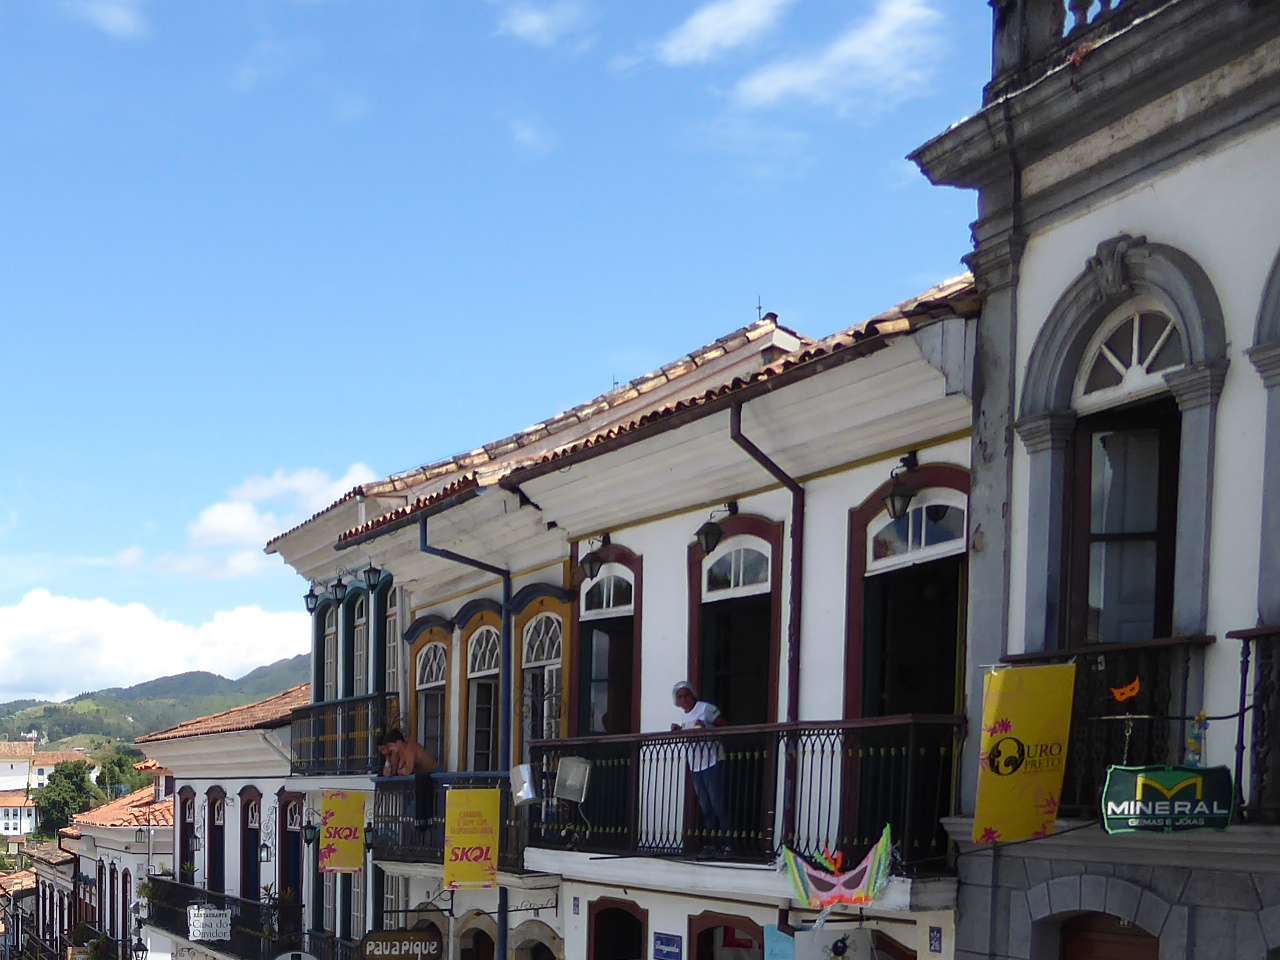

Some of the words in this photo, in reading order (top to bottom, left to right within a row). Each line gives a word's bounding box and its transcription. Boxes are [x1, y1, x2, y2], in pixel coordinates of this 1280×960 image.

[988, 736, 1062, 776] OURO
[1024, 758, 1061, 770] PRETO
[1107, 800, 1229, 815] MINERAL
[1128, 818, 1164, 826] GEMAS
[1174, 816, 1205, 826] JÓIAS
[324, 826, 360, 841] SKOL
[449, 846, 493, 862] SKOL
[192, 919, 213, 929] Casa
[215, 919, 229, 929] do
[192, 929, 228, 938] Ouvidor
